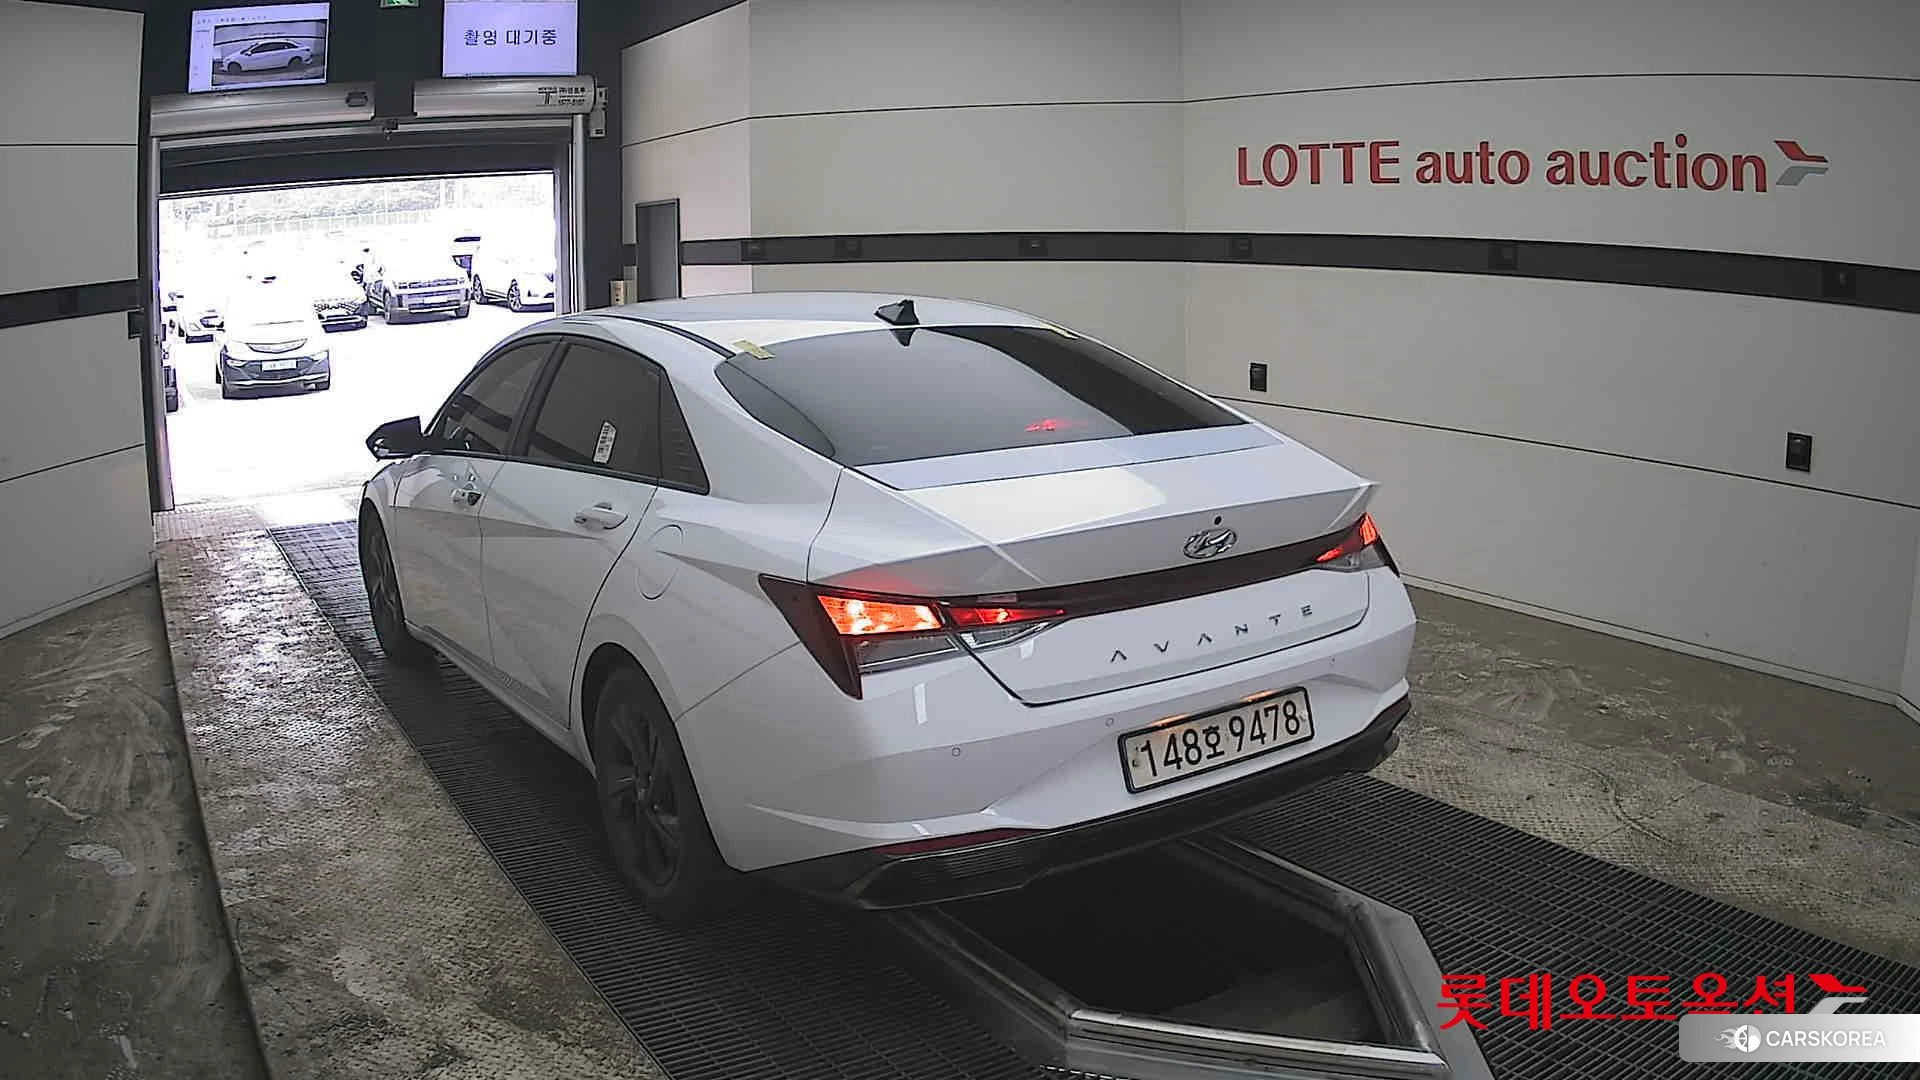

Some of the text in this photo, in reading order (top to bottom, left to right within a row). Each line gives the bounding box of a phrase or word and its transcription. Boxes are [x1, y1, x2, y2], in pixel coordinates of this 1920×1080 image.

[464, 29, 557, 46] 촬영 대기중
[1238, 133, 1767, 193] LOTTE auto auction
[1110, 604, 1313, 663] AVANTE
